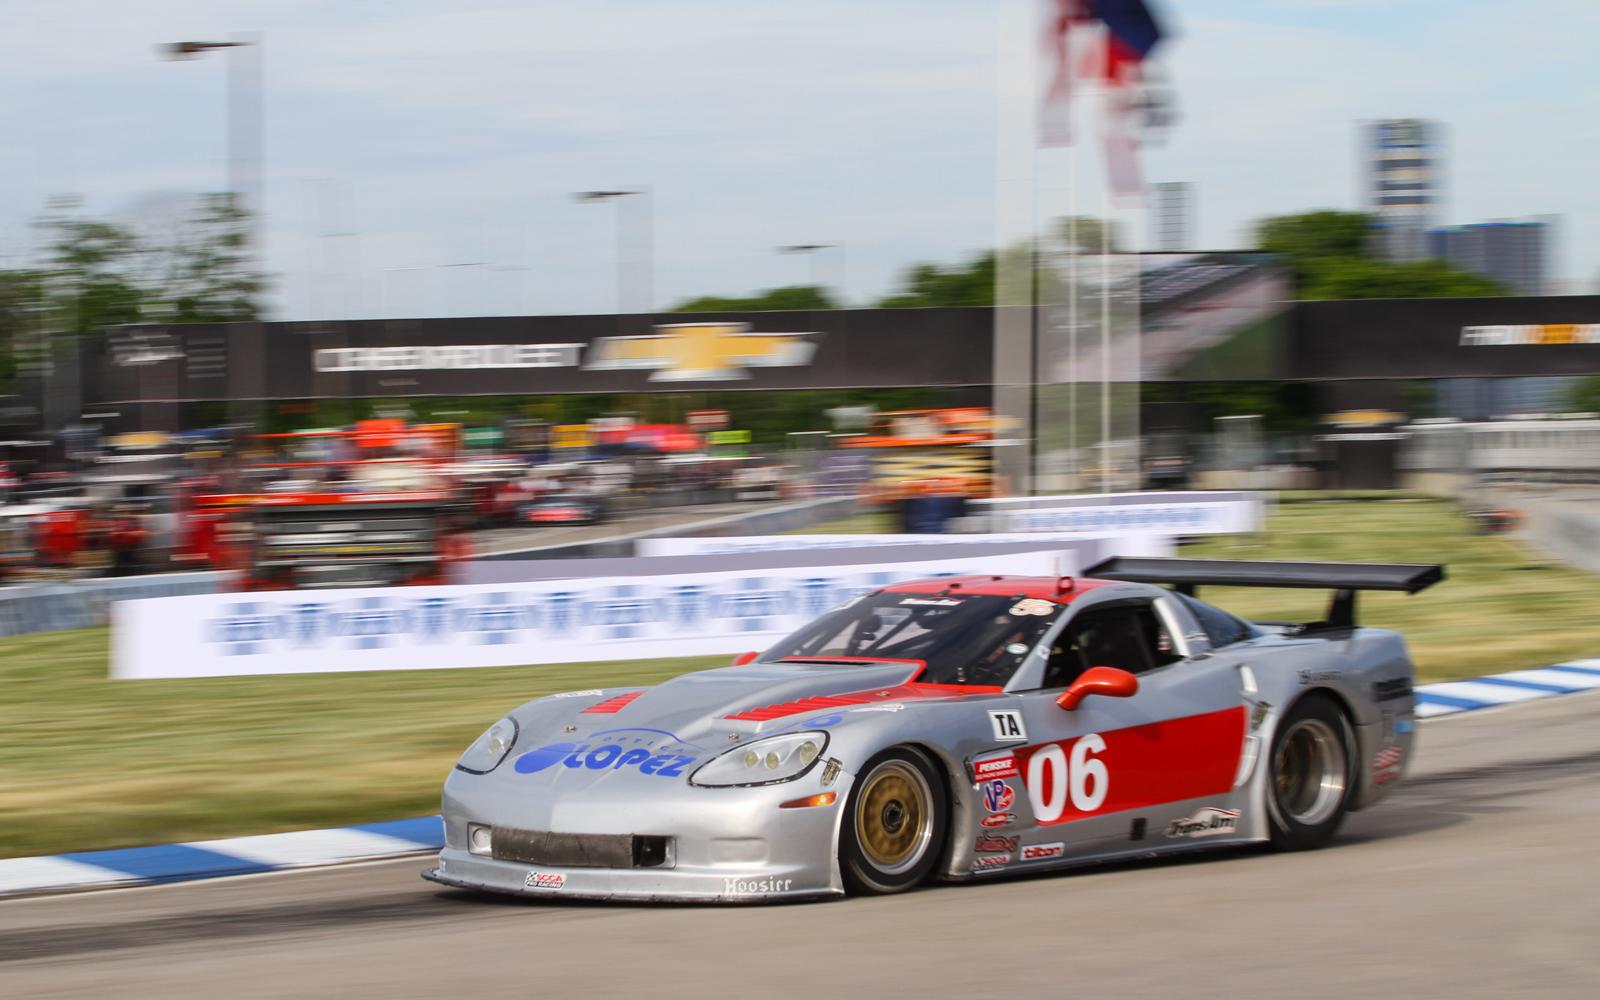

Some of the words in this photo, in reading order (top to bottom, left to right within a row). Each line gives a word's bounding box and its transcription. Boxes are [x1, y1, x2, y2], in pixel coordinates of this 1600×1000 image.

[994, 714, 1021, 736] TA
[563, 745, 696, 777] LOPEZ
[1027, 733, 1109, 821] 06
[537, 874, 563, 882] SCCA
[724, 876, 792, 894] Hoosier
